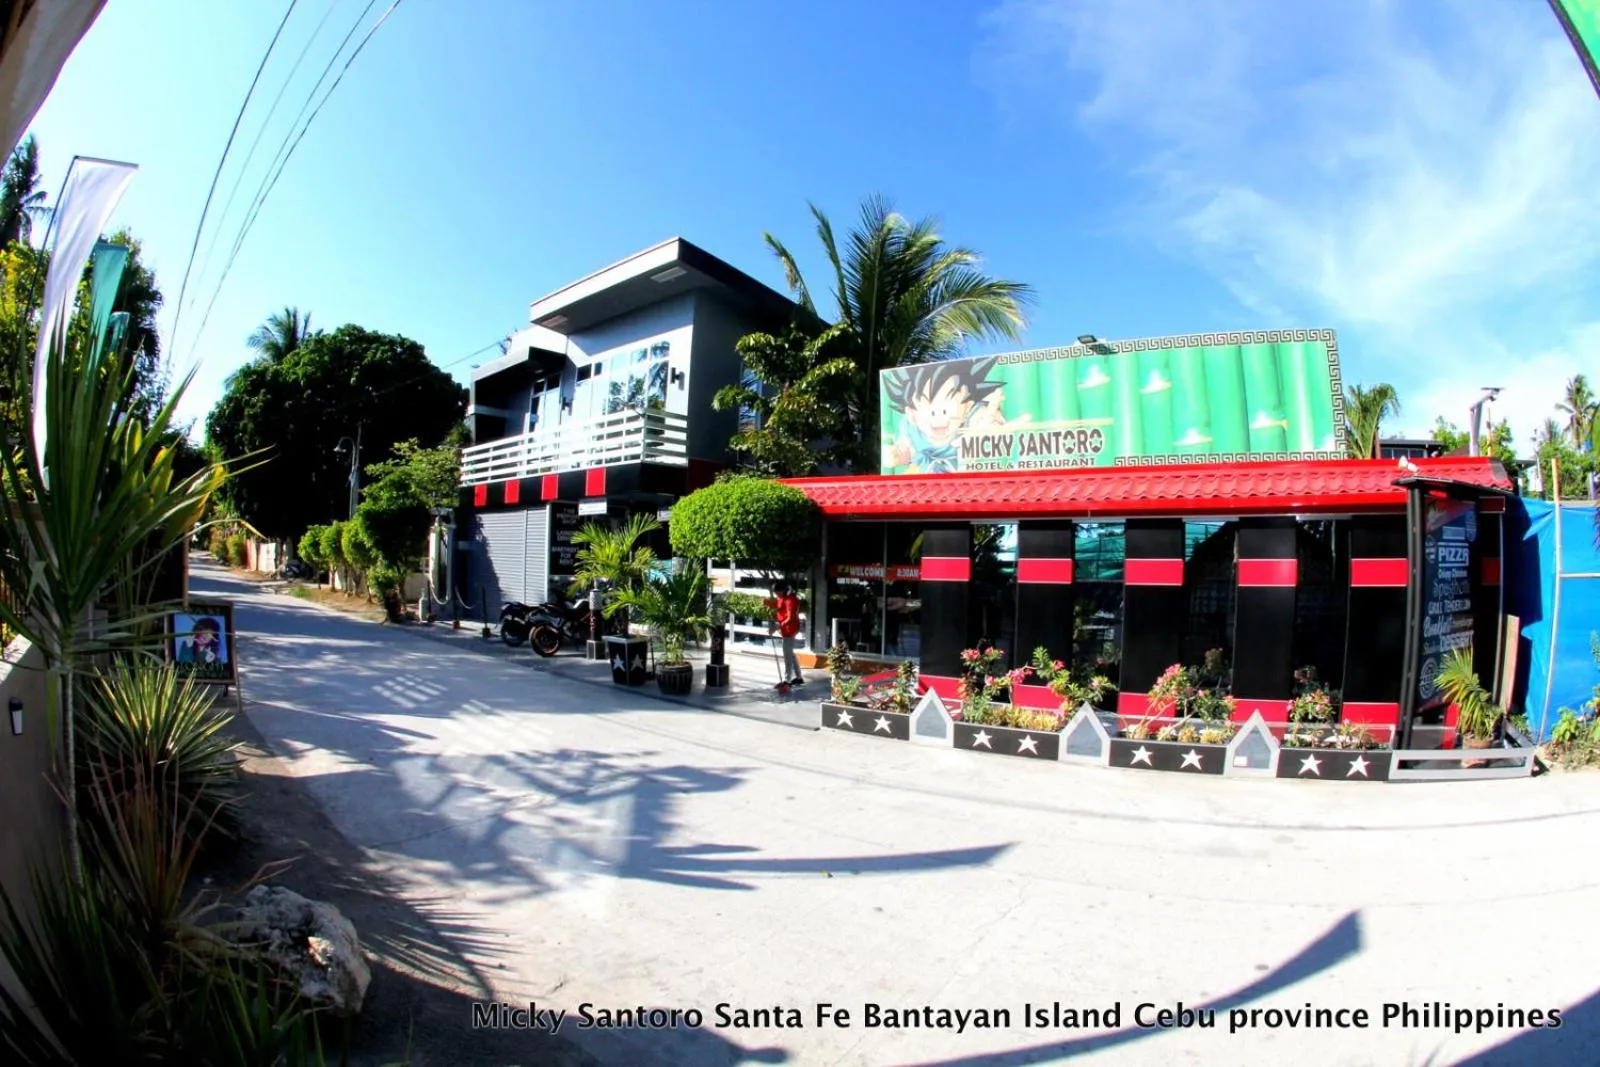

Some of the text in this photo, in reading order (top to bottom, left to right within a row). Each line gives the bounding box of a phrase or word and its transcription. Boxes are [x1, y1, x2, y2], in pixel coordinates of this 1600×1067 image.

[961, 428, 1103, 459] MICKY SANTORO
[966, 461, 1005, 471] HOTEL
[1018, 457, 1095, 470] RESTAURANT
[1438, 547, 1469, 563] PIZZA
